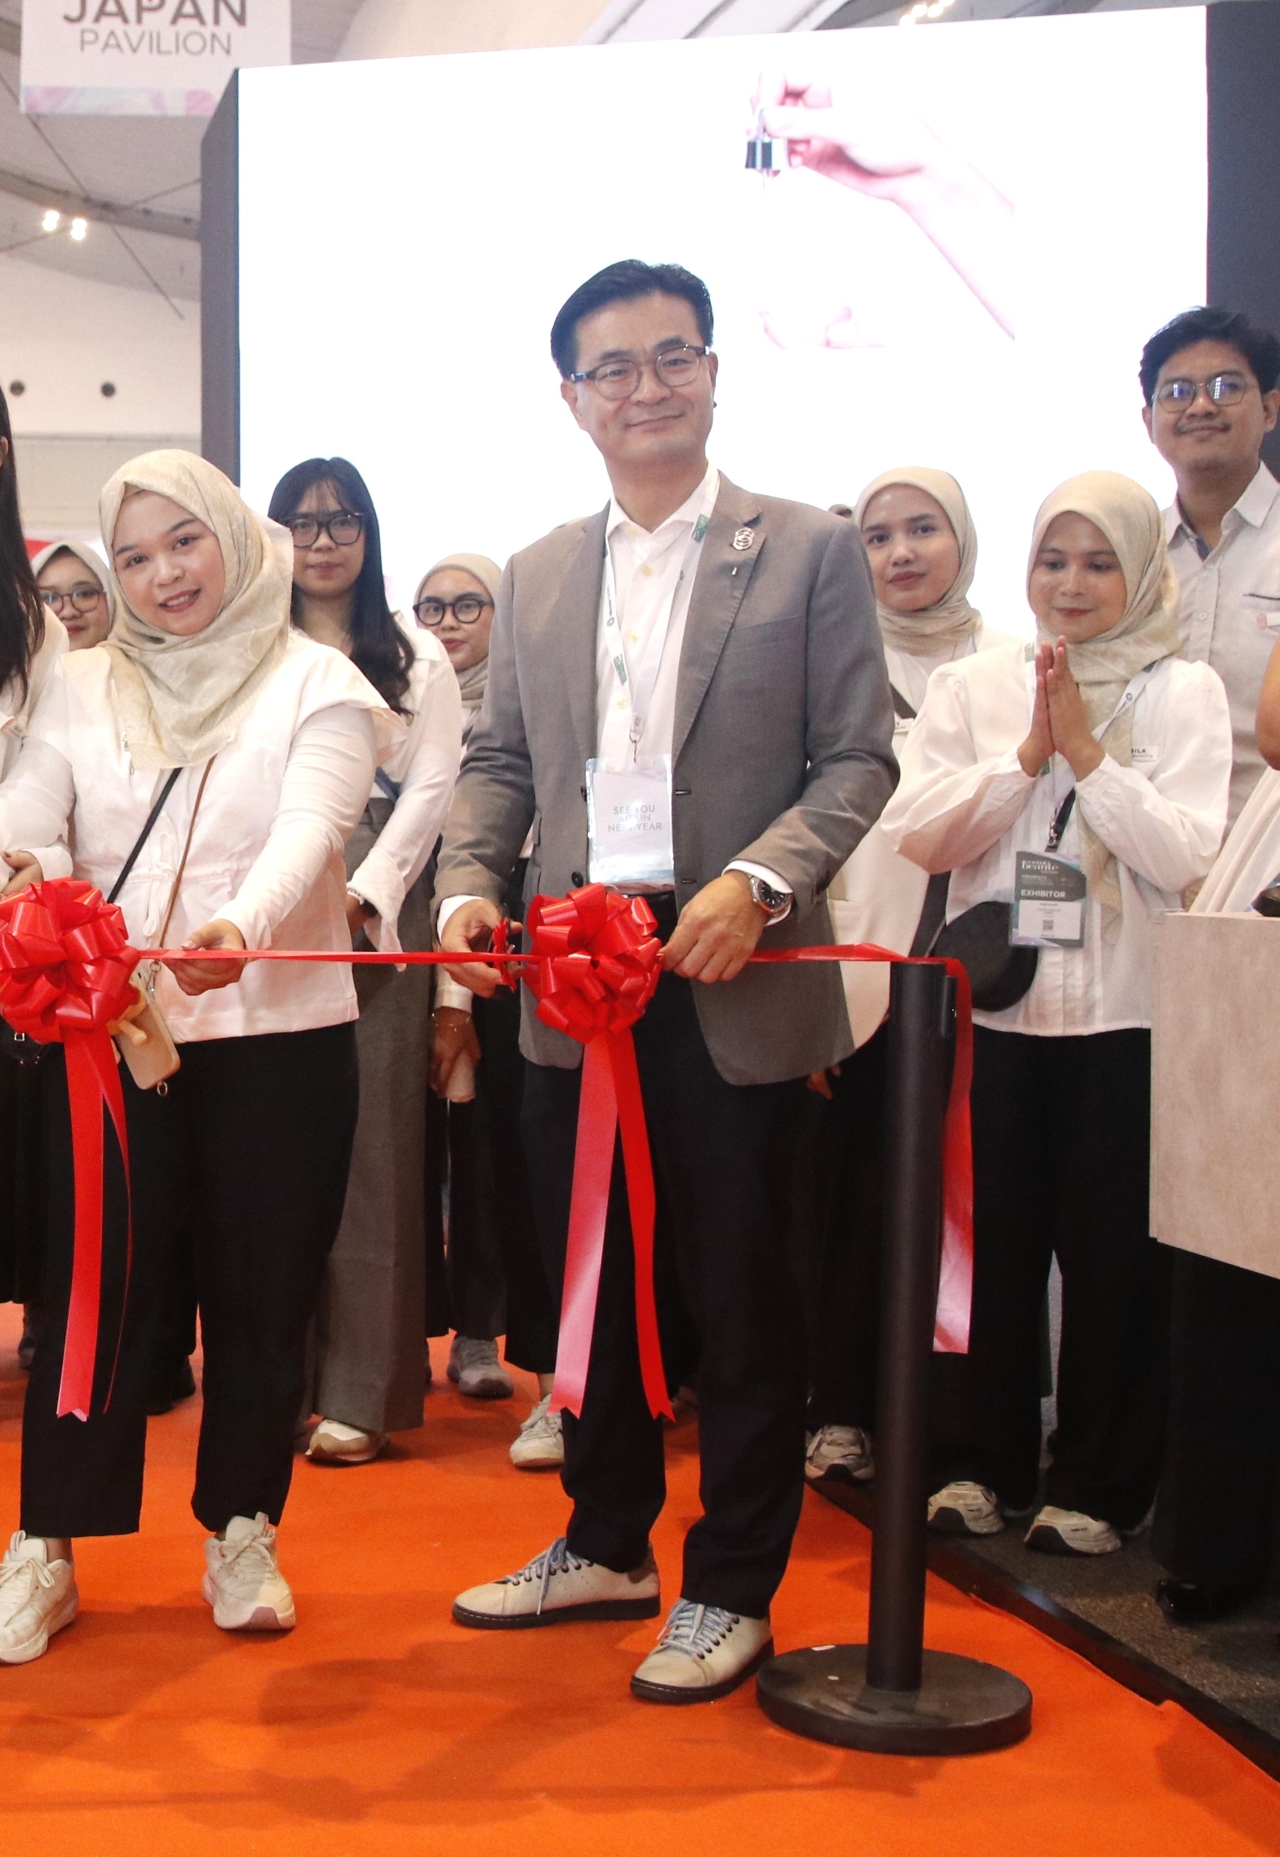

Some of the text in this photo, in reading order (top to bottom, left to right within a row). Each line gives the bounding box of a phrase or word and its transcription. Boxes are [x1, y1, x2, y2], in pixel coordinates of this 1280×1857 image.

[63, 0, 247, 26] JAPAN
[79, 28, 232, 56] PAVILION
[613, 806, 631, 815] SEE
[618, 813, 651, 823] AIN
[608, 822, 663, 832] NE YEAR
[1020, 889, 1066, 898] EXHIBITOR
